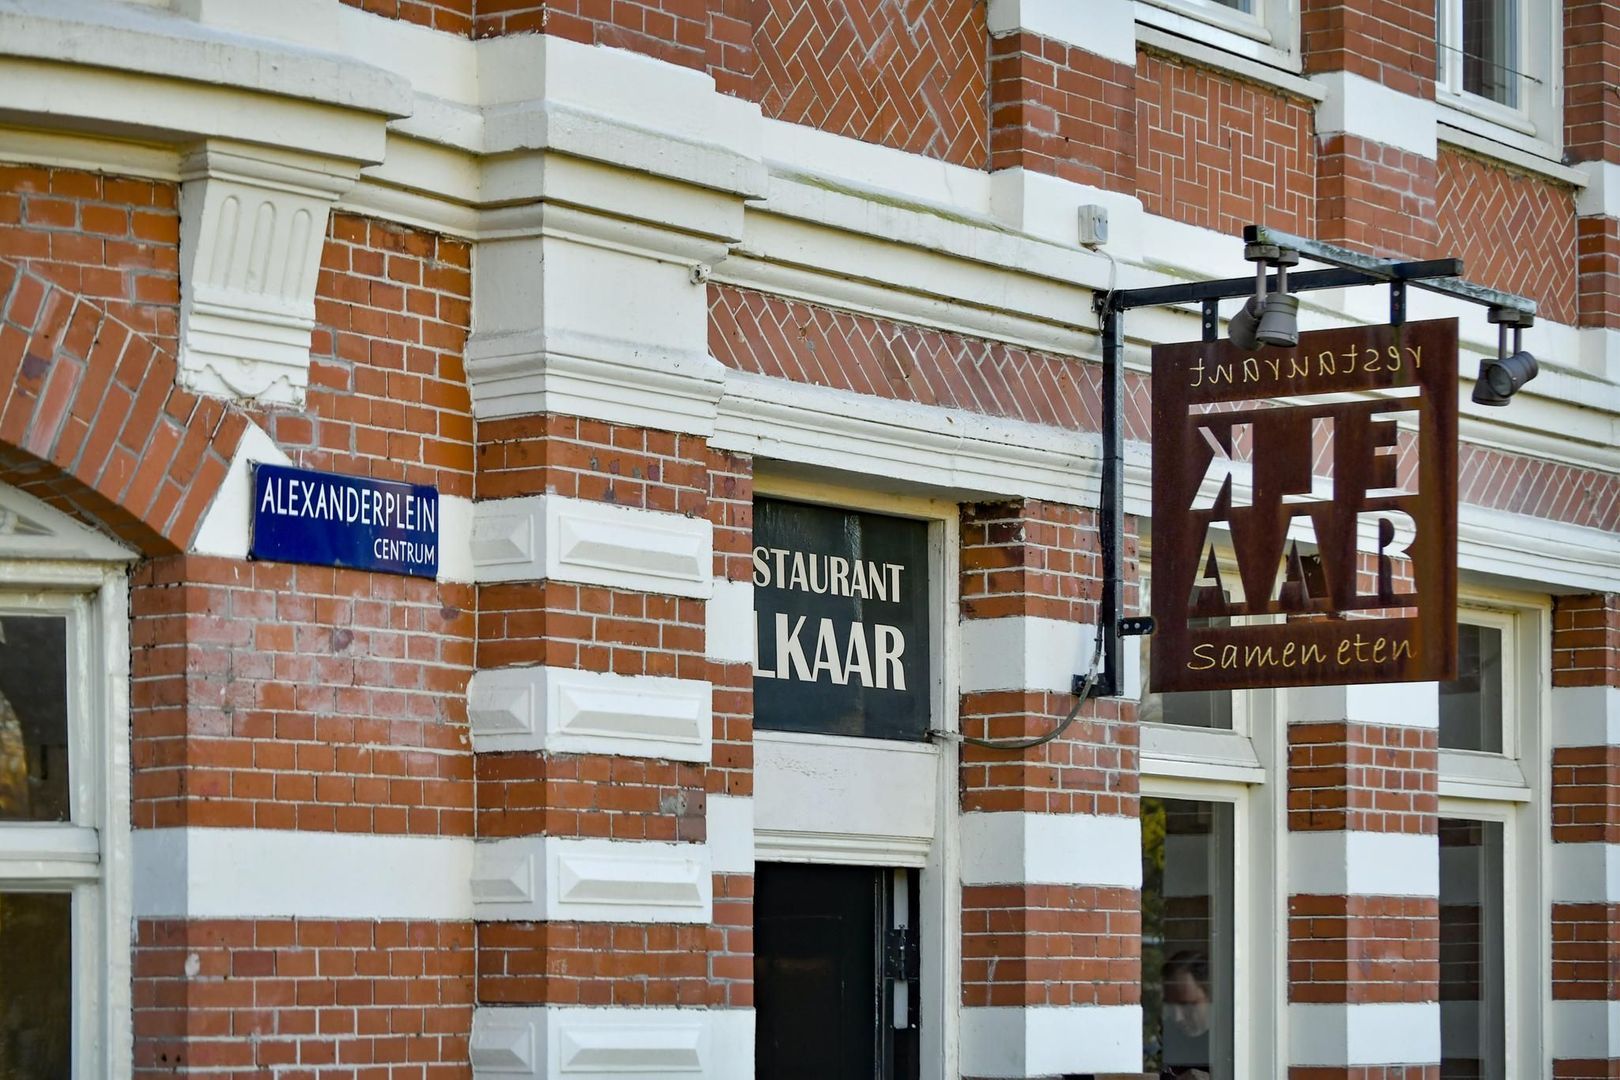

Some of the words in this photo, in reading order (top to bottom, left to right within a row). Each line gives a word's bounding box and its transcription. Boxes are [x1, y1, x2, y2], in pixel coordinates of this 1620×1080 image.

[261, 476, 435, 533] ALEXANDERPLEIN
[374, 538, 435, 565] CENTRUM
[752, 546, 905, 603] STAURANT
[1187, 509, 1419, 607] AAR
[1186, 641, 1327, 671] samen
[1336, 633, 1418, 665] eten
